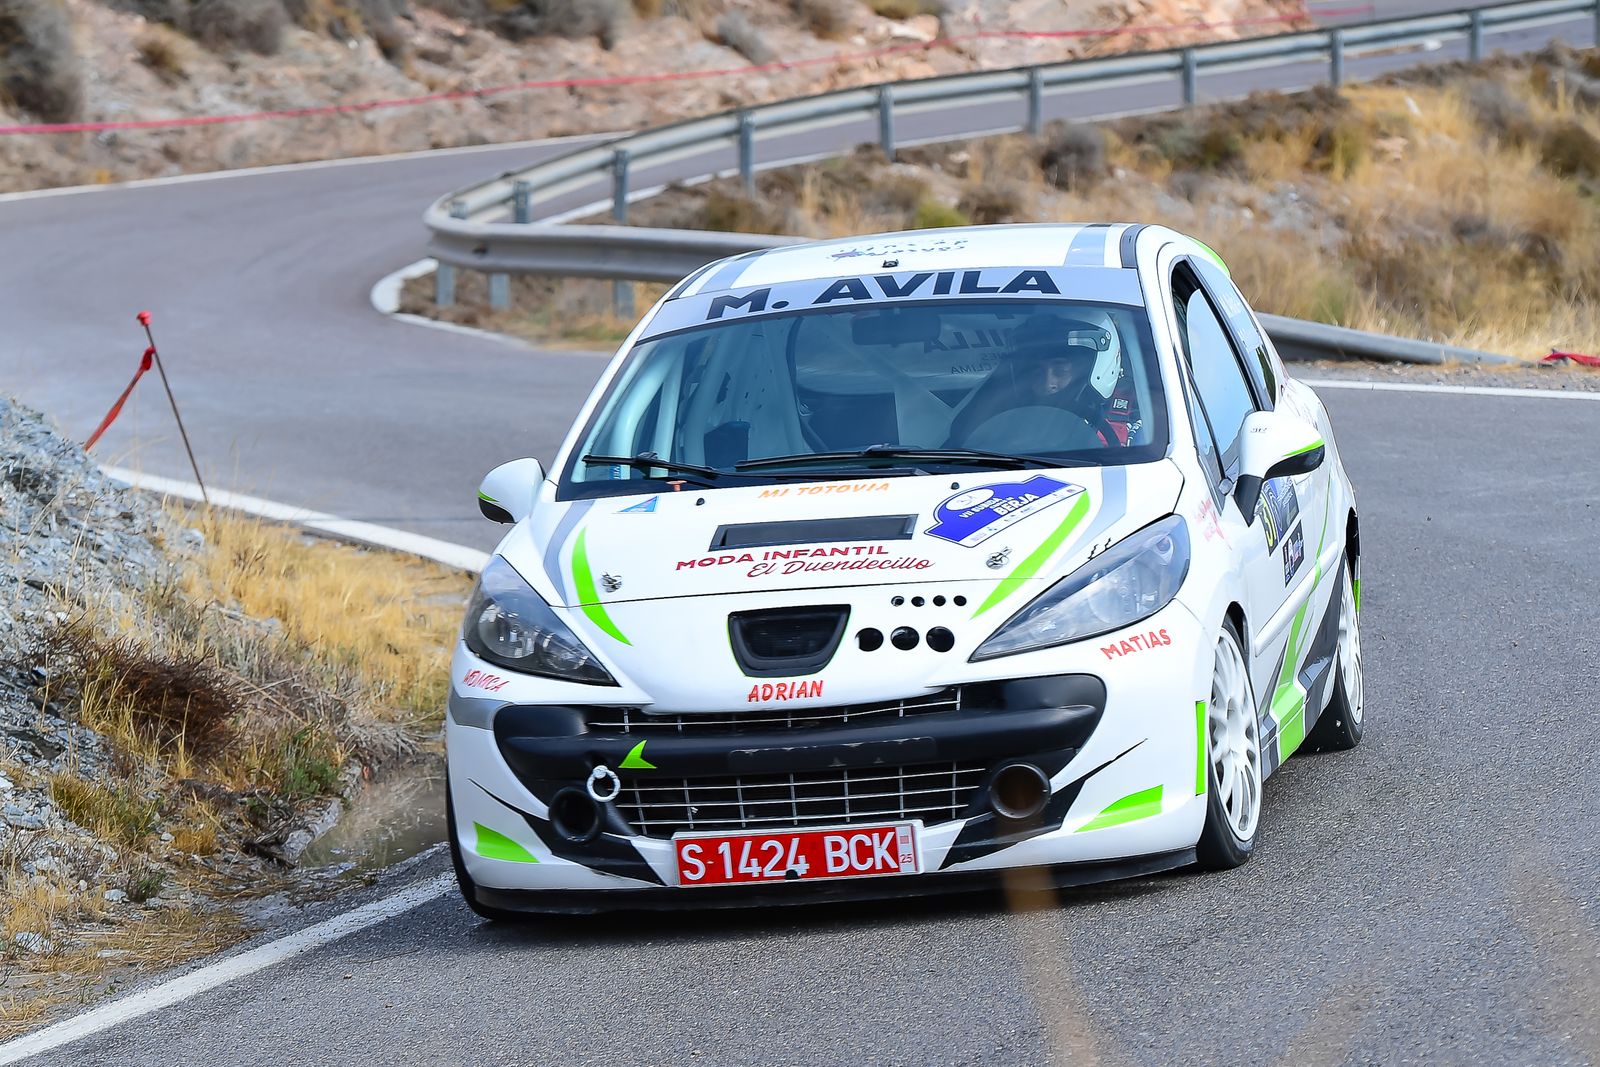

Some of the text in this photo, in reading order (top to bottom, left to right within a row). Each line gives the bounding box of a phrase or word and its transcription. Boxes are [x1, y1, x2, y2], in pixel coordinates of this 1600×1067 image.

[706, 269, 1062, 320] M. AVILA
[758, 483, 890, 499] MI TOTOVIA
[993, 493, 1040, 517] BERJA
[675, 545, 889, 571] MODA INFANTIL
[747, 556, 936, 578] El Duendecillo
[1100, 628, 1171, 660] MATIAS
[747, 679, 824, 702] ADRIAN
[823, 831, 899, 873] BCK
[900, 853, 913, 864] 25
